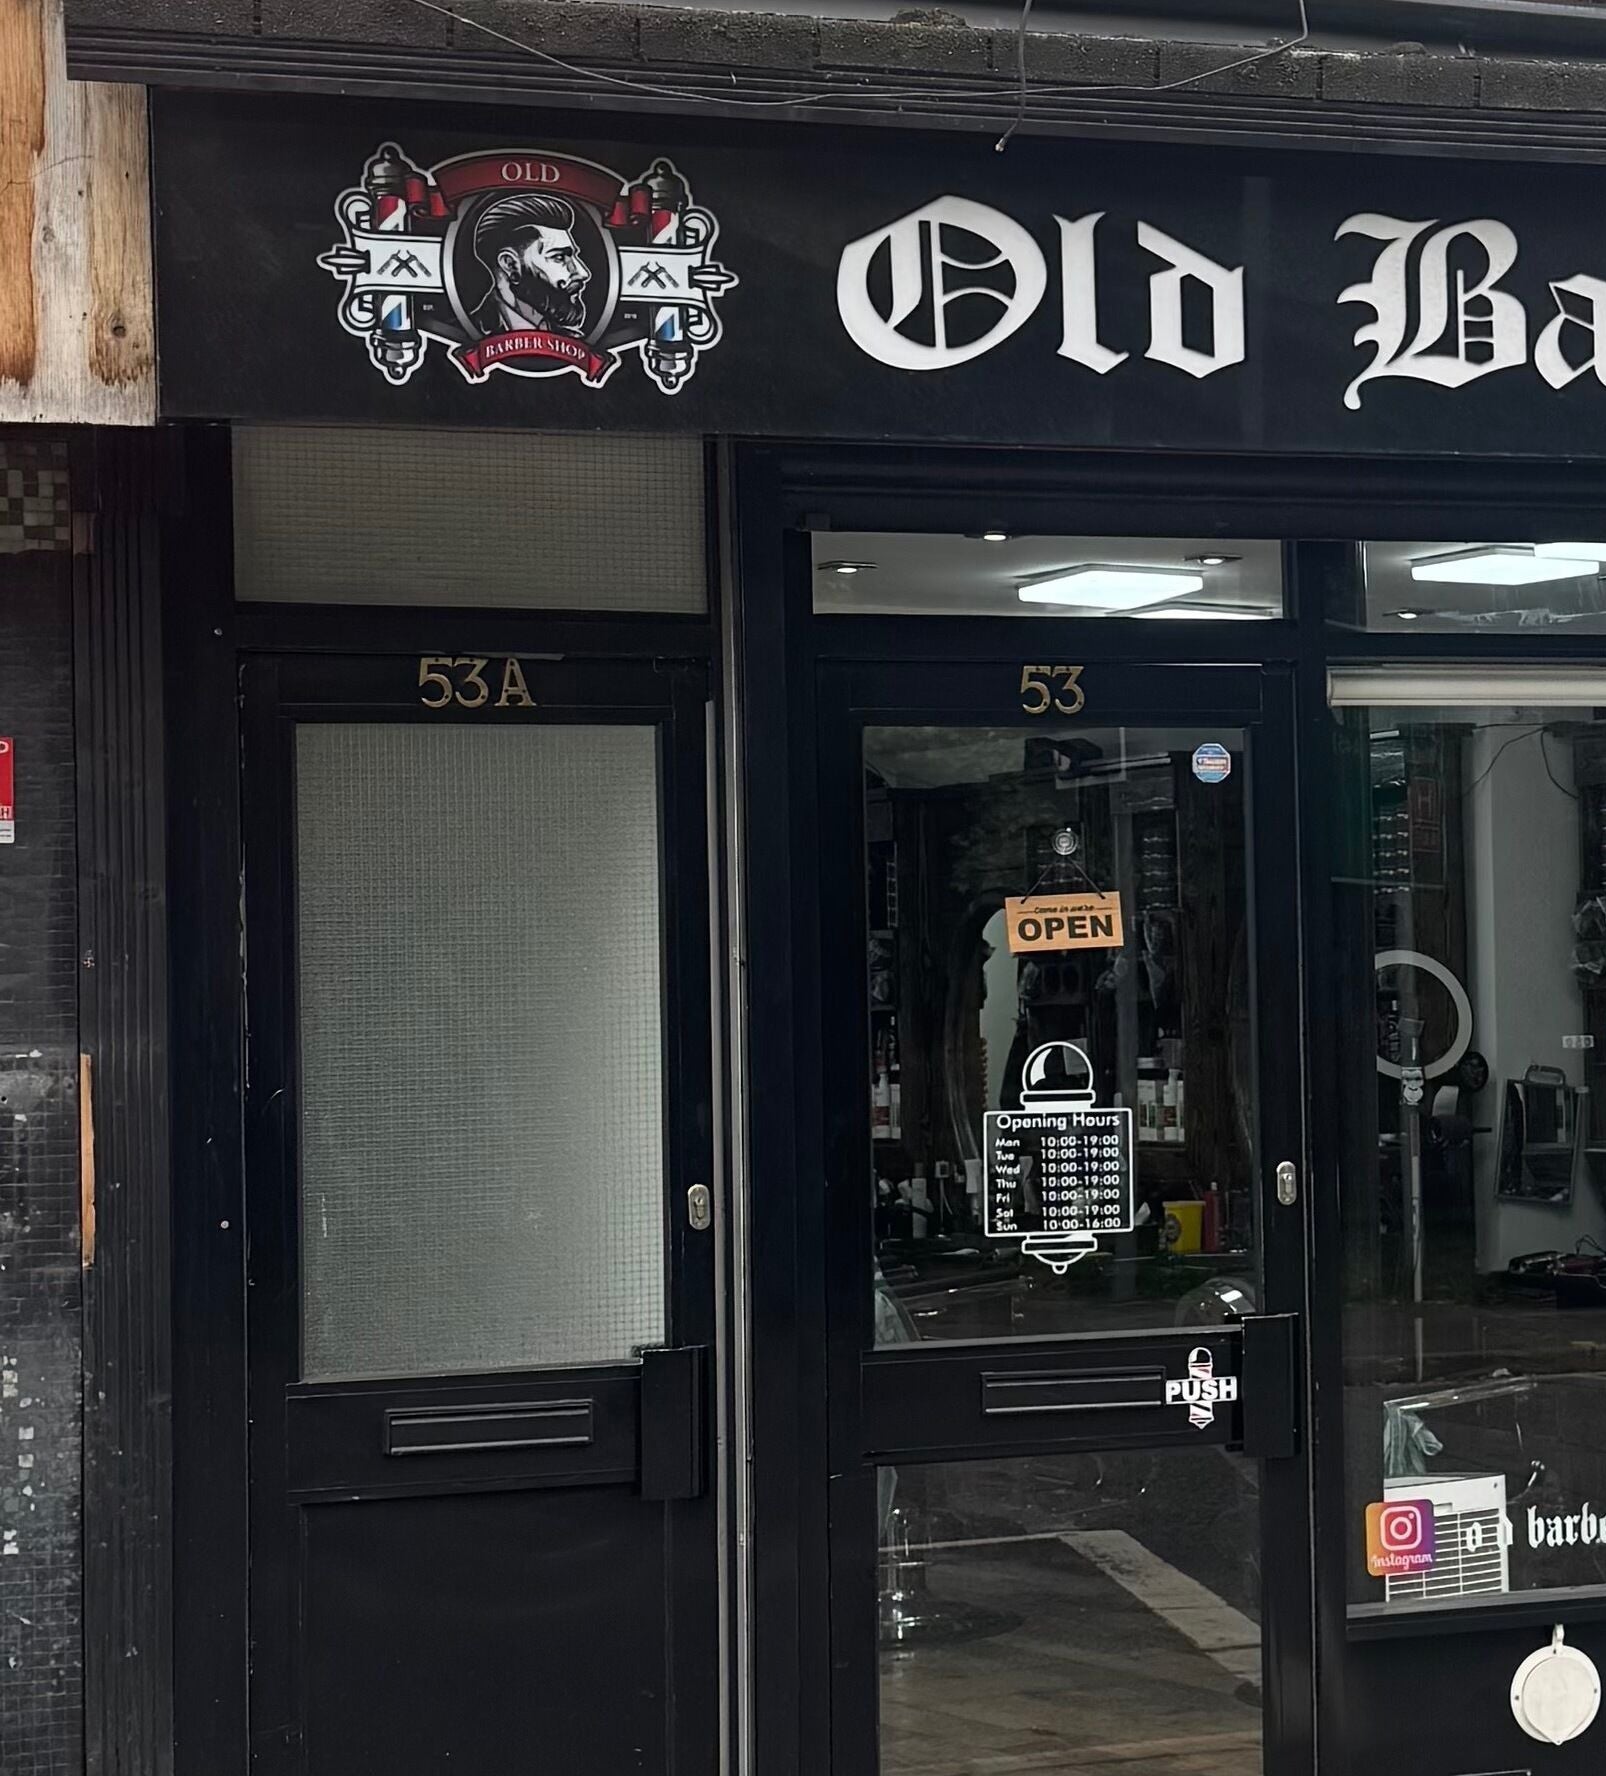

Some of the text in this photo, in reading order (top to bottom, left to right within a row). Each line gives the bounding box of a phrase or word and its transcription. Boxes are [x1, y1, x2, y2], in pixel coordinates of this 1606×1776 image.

[501, 162, 560, 182] OLD
[836, 194, 1247, 379] Old
[485, 336, 586, 360] BARBER SHOP
[418, 656, 537, 708] 53A
[1020, 665, 1086, 714] 53
[1018, 914, 1114, 941] OPEN
[996, 1112, 1121, 1133] Opening Hours
[995, 1138, 1020, 1147] Mon
[996, 1150, 1015, 1161] Tue
[995, 1164, 1021, 1175] Wed
[996, 1178, 1017, 1189] Thu
[996, 1193, 1010, 1203] Fri
[996, 1208, 1014, 1218] Sat
[996, 1222, 1018, 1231] Sun
[1166, 1377, 1237, 1403] PUSH
